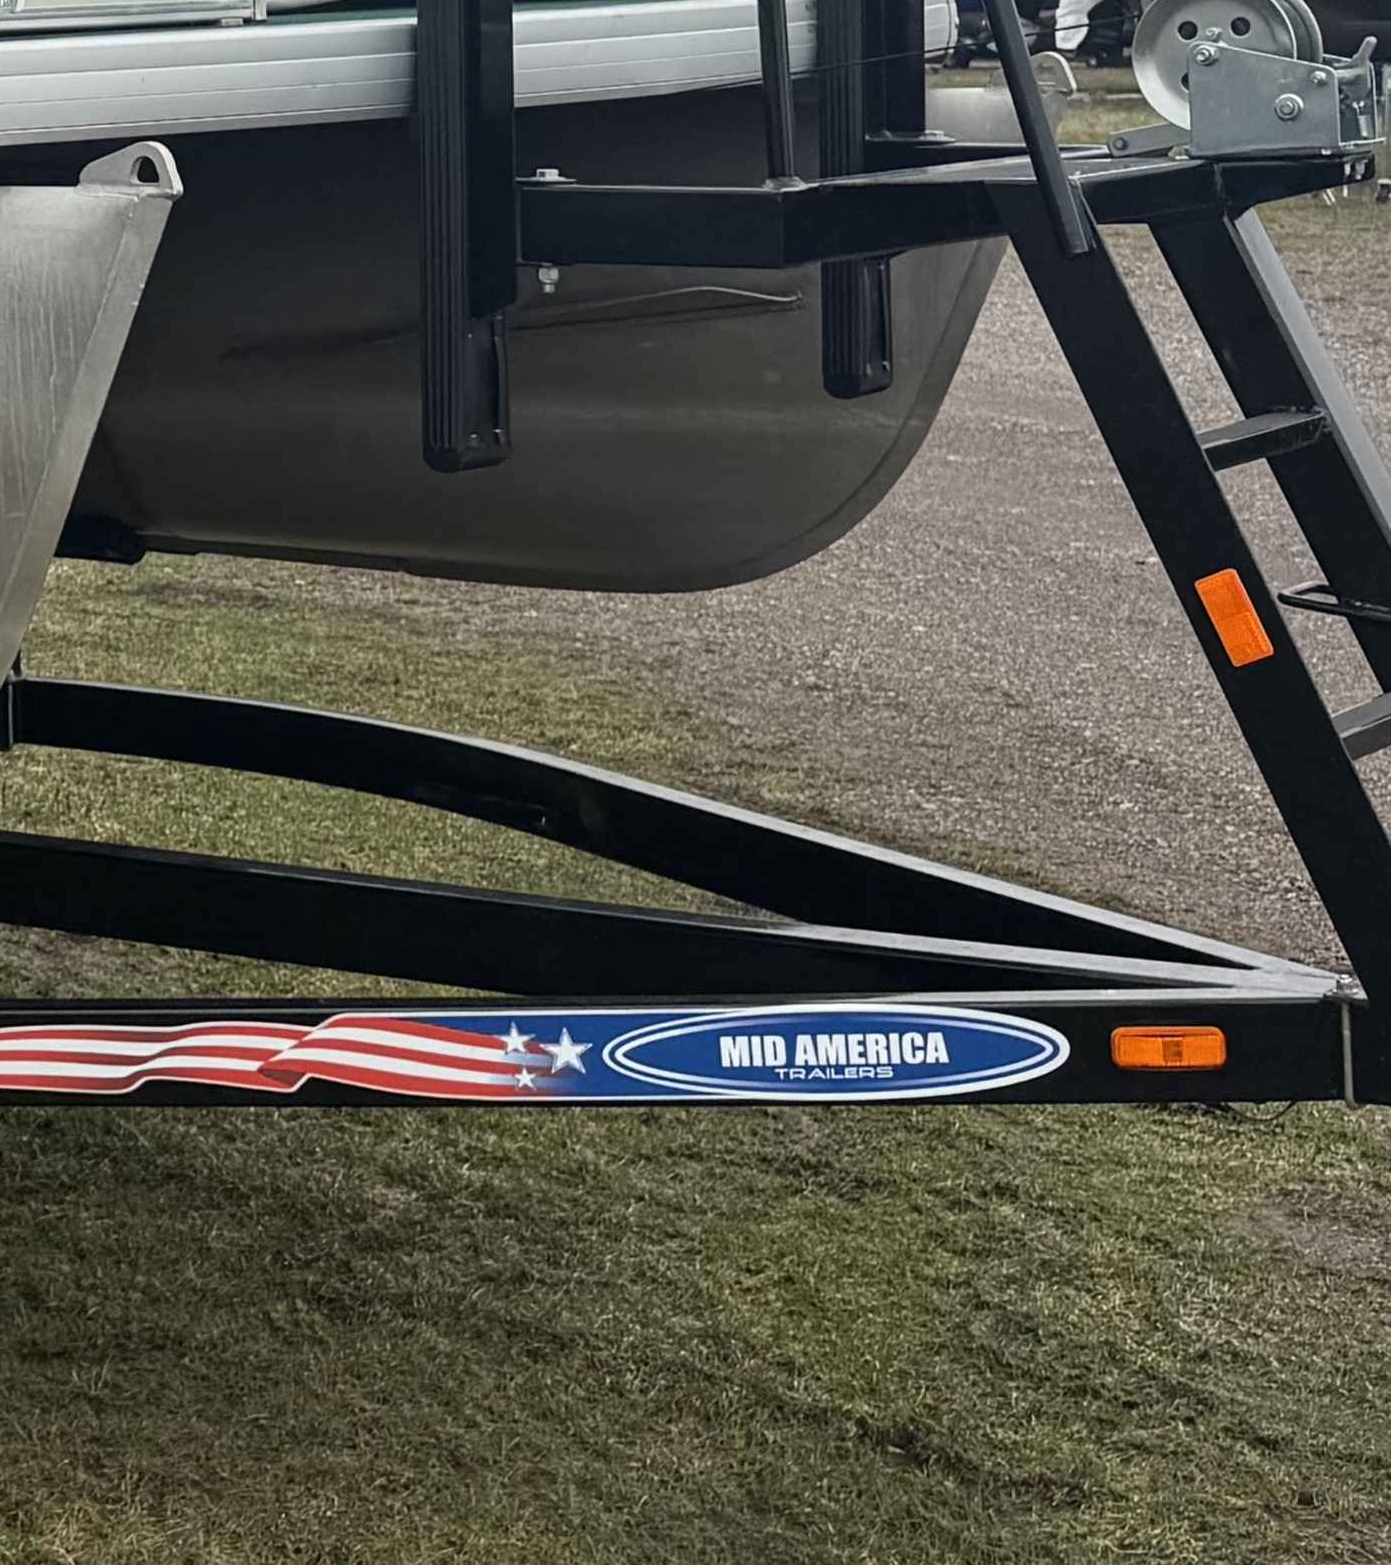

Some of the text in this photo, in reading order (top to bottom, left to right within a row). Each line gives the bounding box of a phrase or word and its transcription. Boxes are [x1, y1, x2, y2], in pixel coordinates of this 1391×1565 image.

[720, 1032, 949, 1067] MID AMERICA
[774, 1066, 893, 1080] TRAILERS
